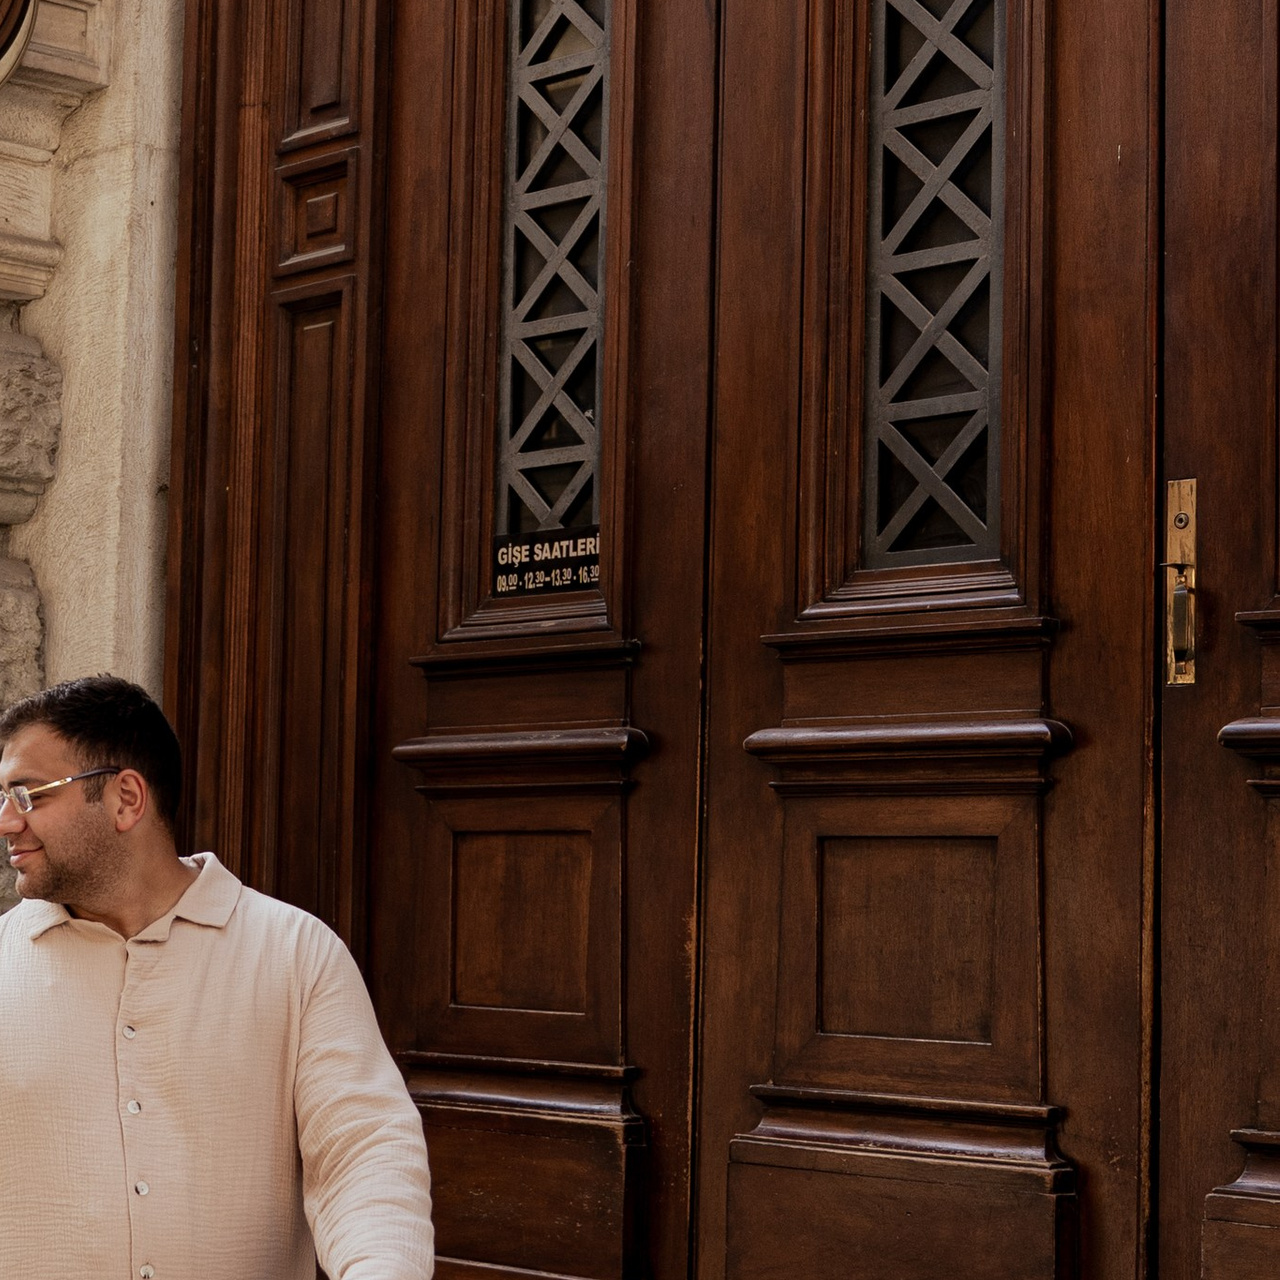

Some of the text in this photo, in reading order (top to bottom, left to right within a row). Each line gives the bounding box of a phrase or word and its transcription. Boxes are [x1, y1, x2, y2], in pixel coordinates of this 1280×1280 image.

[498, 533, 600, 568] GİŞE SAATLERİ
[497, 573, 518, 593] 09.00
[578, 565, 600, 584] 16.30
